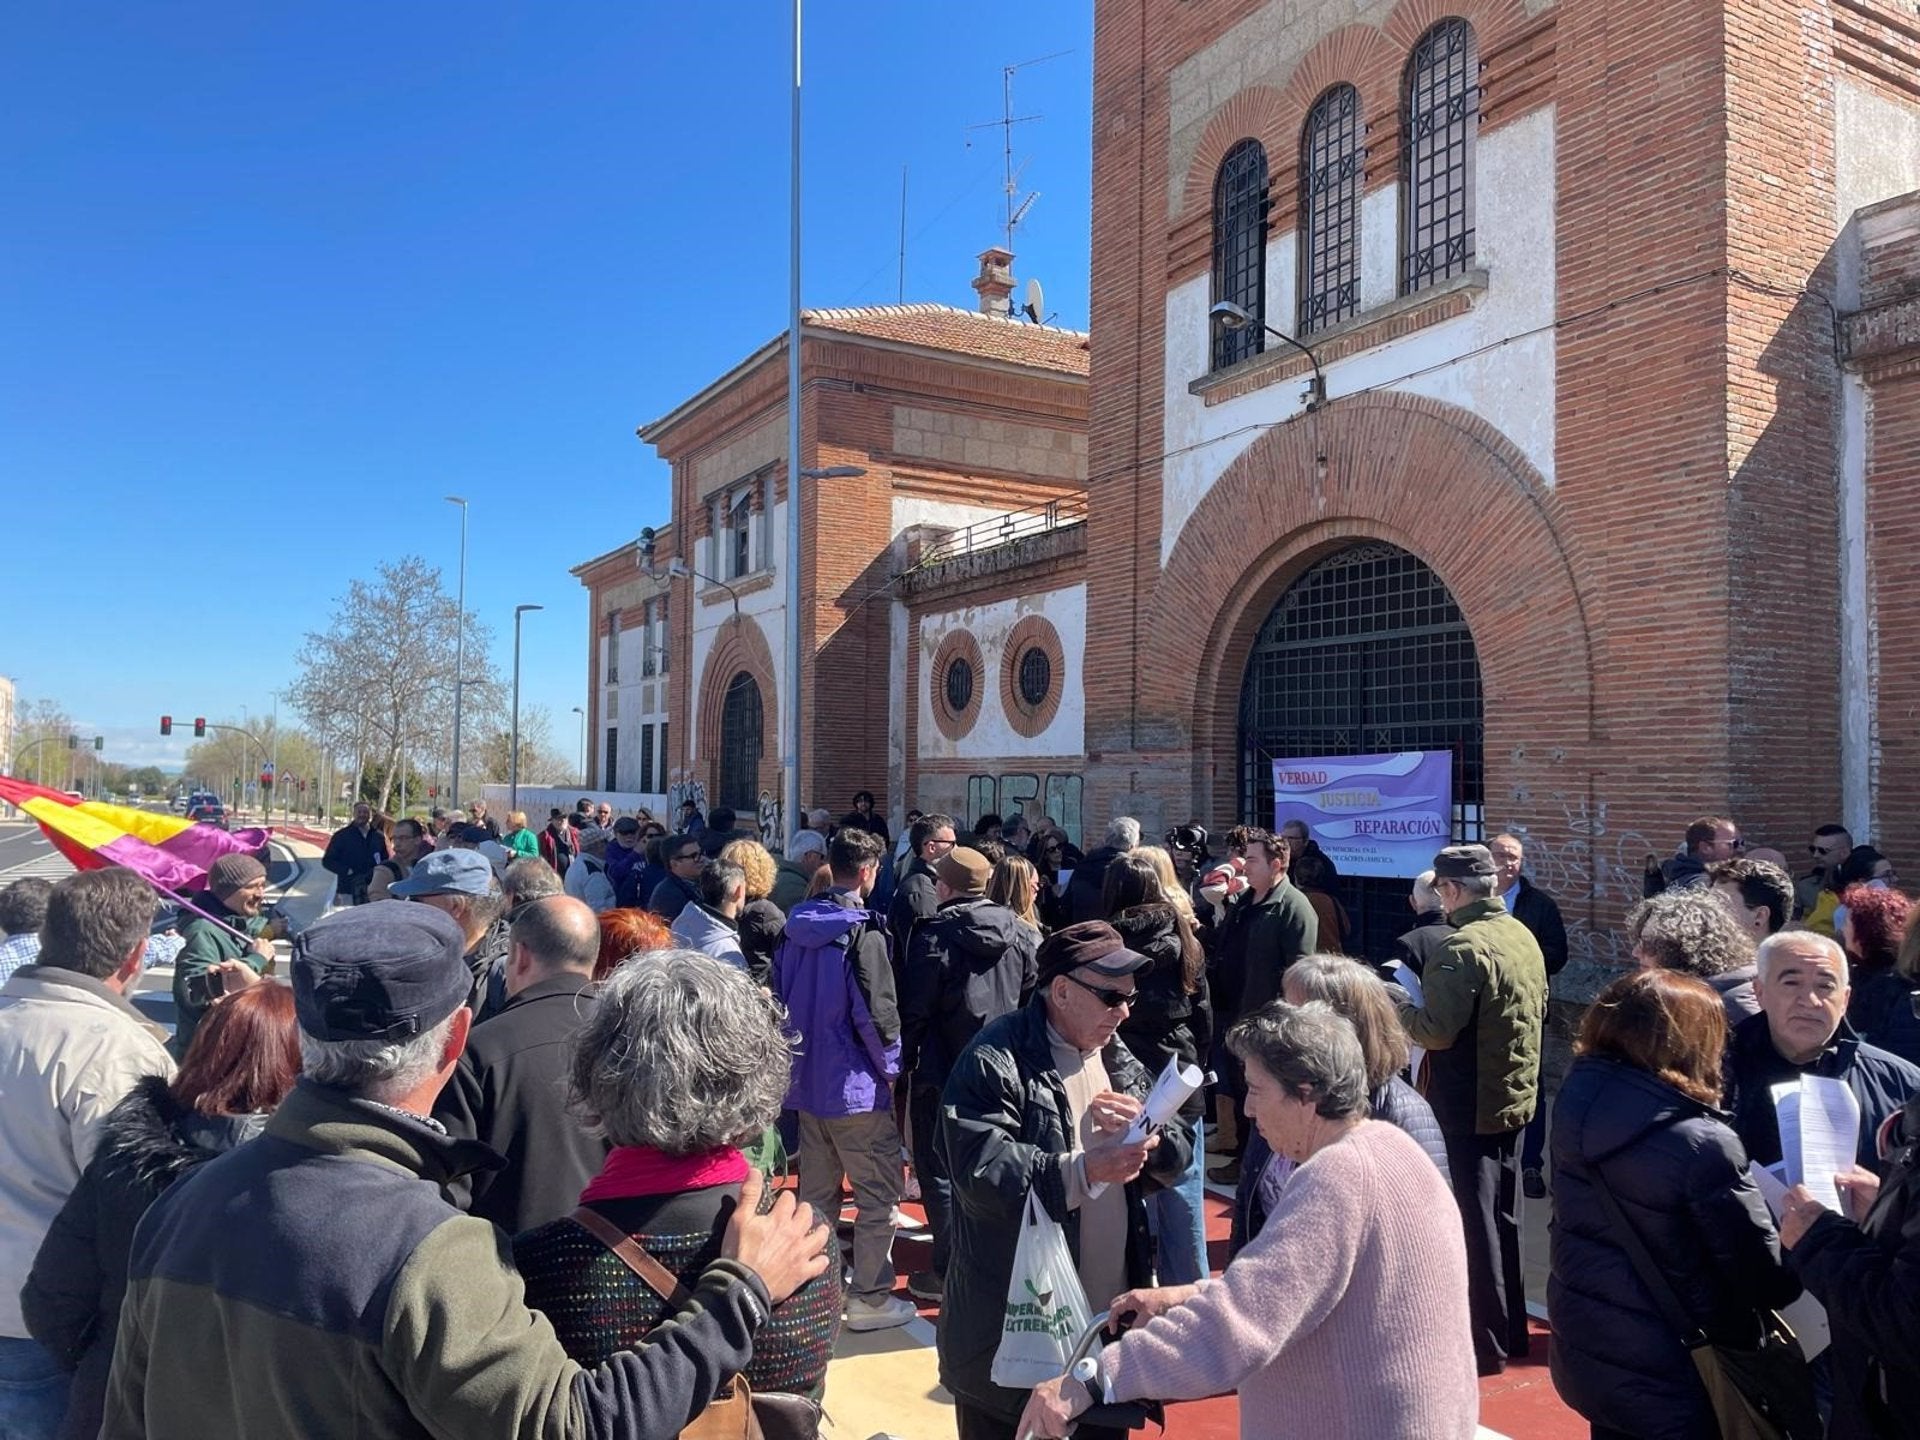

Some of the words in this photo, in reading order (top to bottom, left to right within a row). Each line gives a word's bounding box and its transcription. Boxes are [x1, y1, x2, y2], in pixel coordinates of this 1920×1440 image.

[1278, 771, 1327, 785] VERDAD
[1320, 793, 1380, 808] JUSTICIA
[1354, 816, 1441, 834] REPARACIÓN
